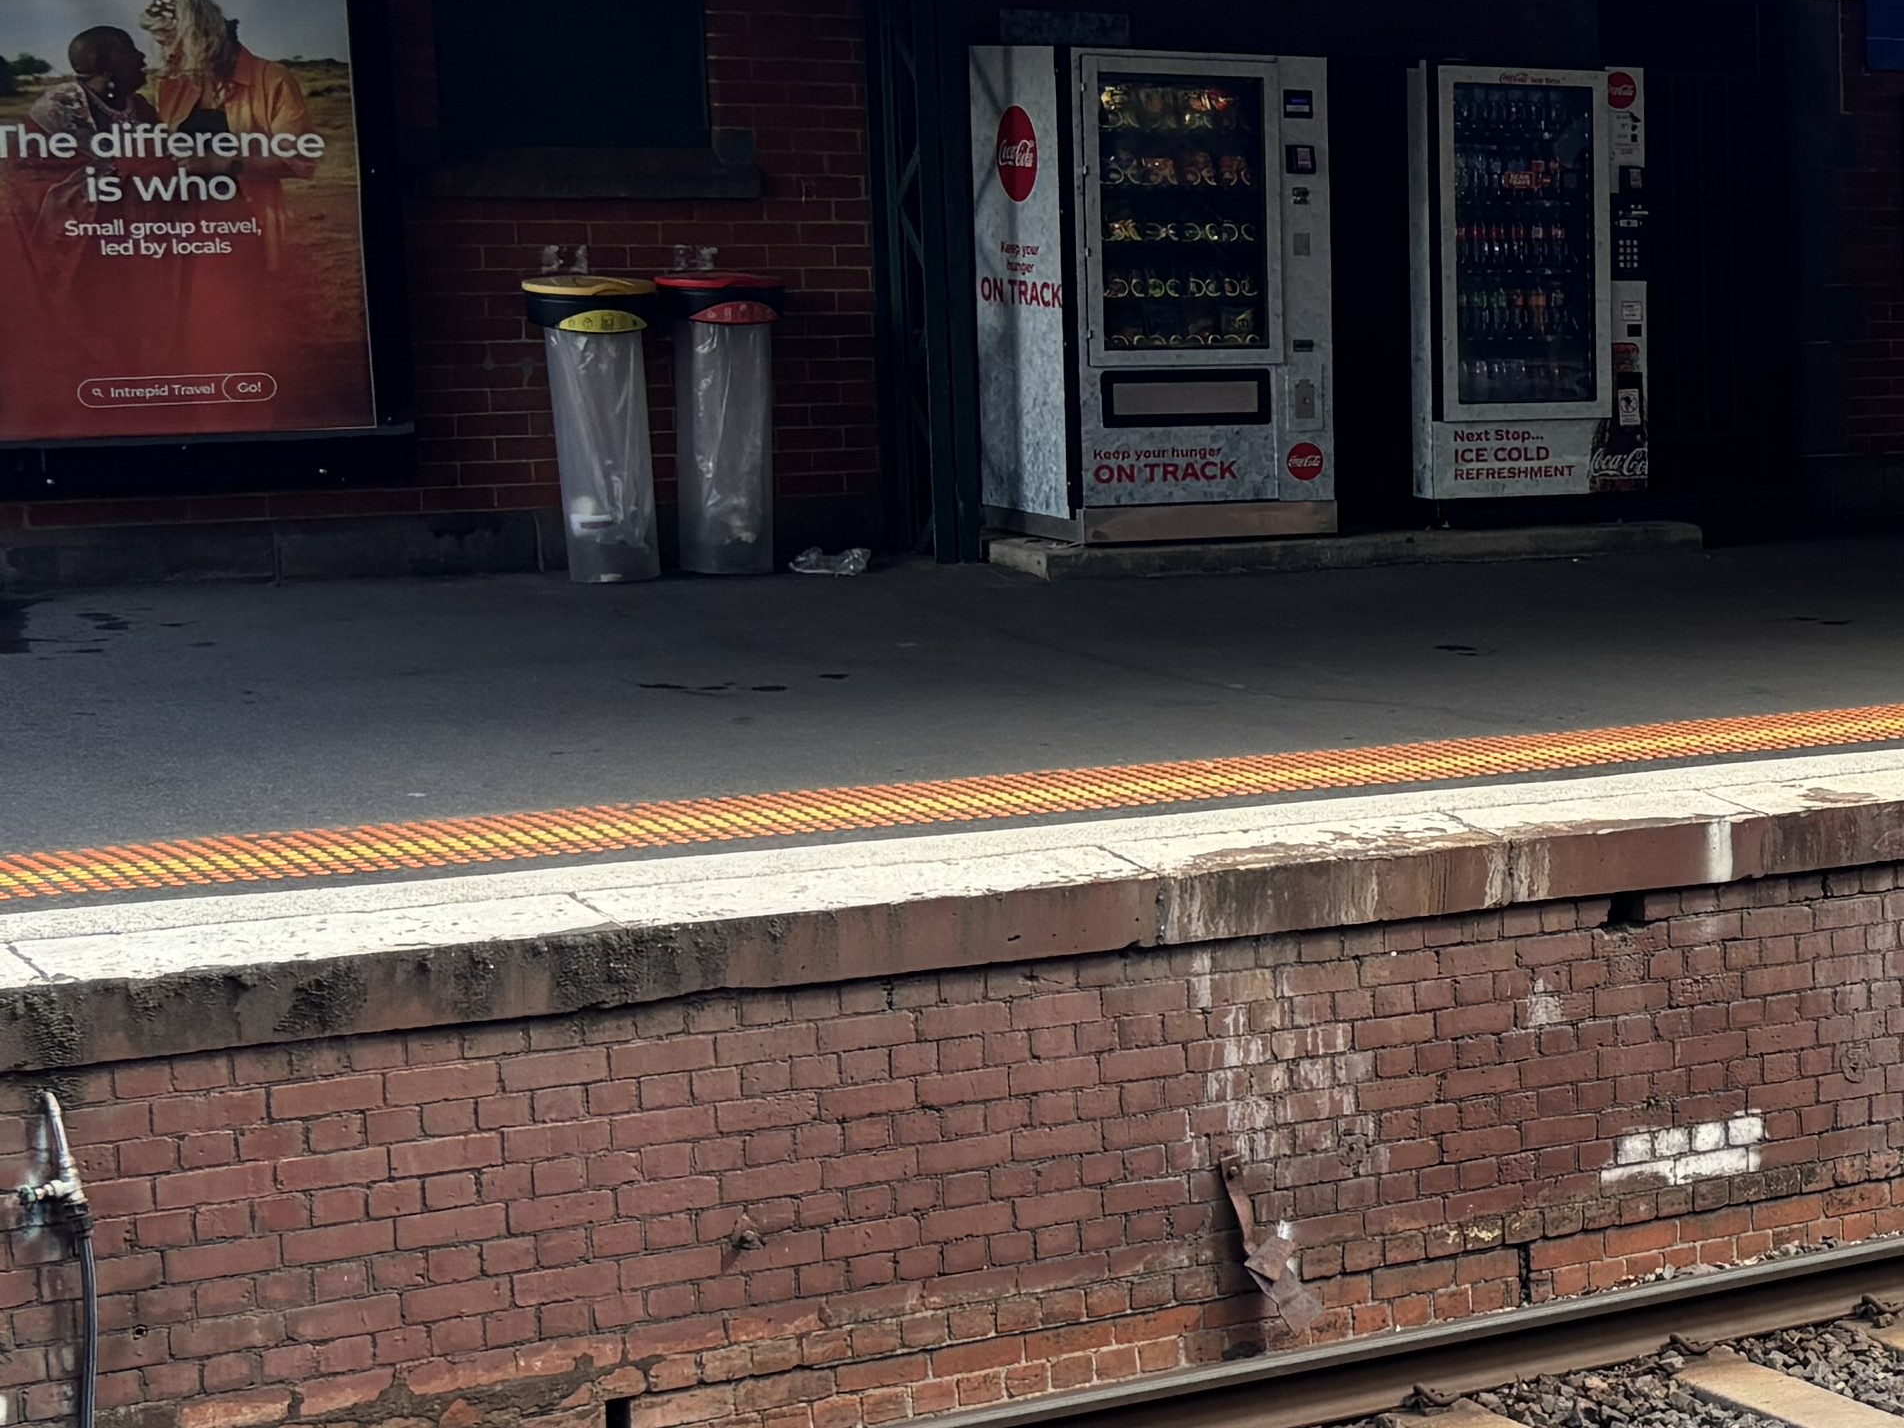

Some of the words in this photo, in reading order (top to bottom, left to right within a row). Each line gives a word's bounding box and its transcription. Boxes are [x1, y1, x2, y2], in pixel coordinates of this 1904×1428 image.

[0, 122, 78, 160] The
[91, 123, 325, 159] difference
[86, 166, 122, 203] is
[134, 166, 237, 201] who
[64, 219, 125, 237] Small
[130, 220, 196, 239] group
[200, 217, 262, 236] travel,
[101, 239, 134, 256] led
[140, 239, 167, 259] by
[172, 237, 233, 255] locals
[981, 276, 1004, 303] ON
[1007, 278, 1062, 309] TRACK
[110, 383, 169, 399] Intrepid
[171, 381, 216, 397] Travel
[236, 381, 262, 393] Go!
[1453, 430, 1490, 443] Next
[1494, 429, 1544, 442] Stop...
[1093, 448, 1131, 461] Keep
[1134, 448, 1167, 461] your
[1171, 447, 1223, 460] hunger
[1454, 448, 1488, 464] ICE
[1493, 446, 1550, 463] COLD
[1093, 463, 1136, 484] ON
[1143, 460, 1238, 483] TRACK
[1454, 464, 1575, 481] REFRESHMENT
